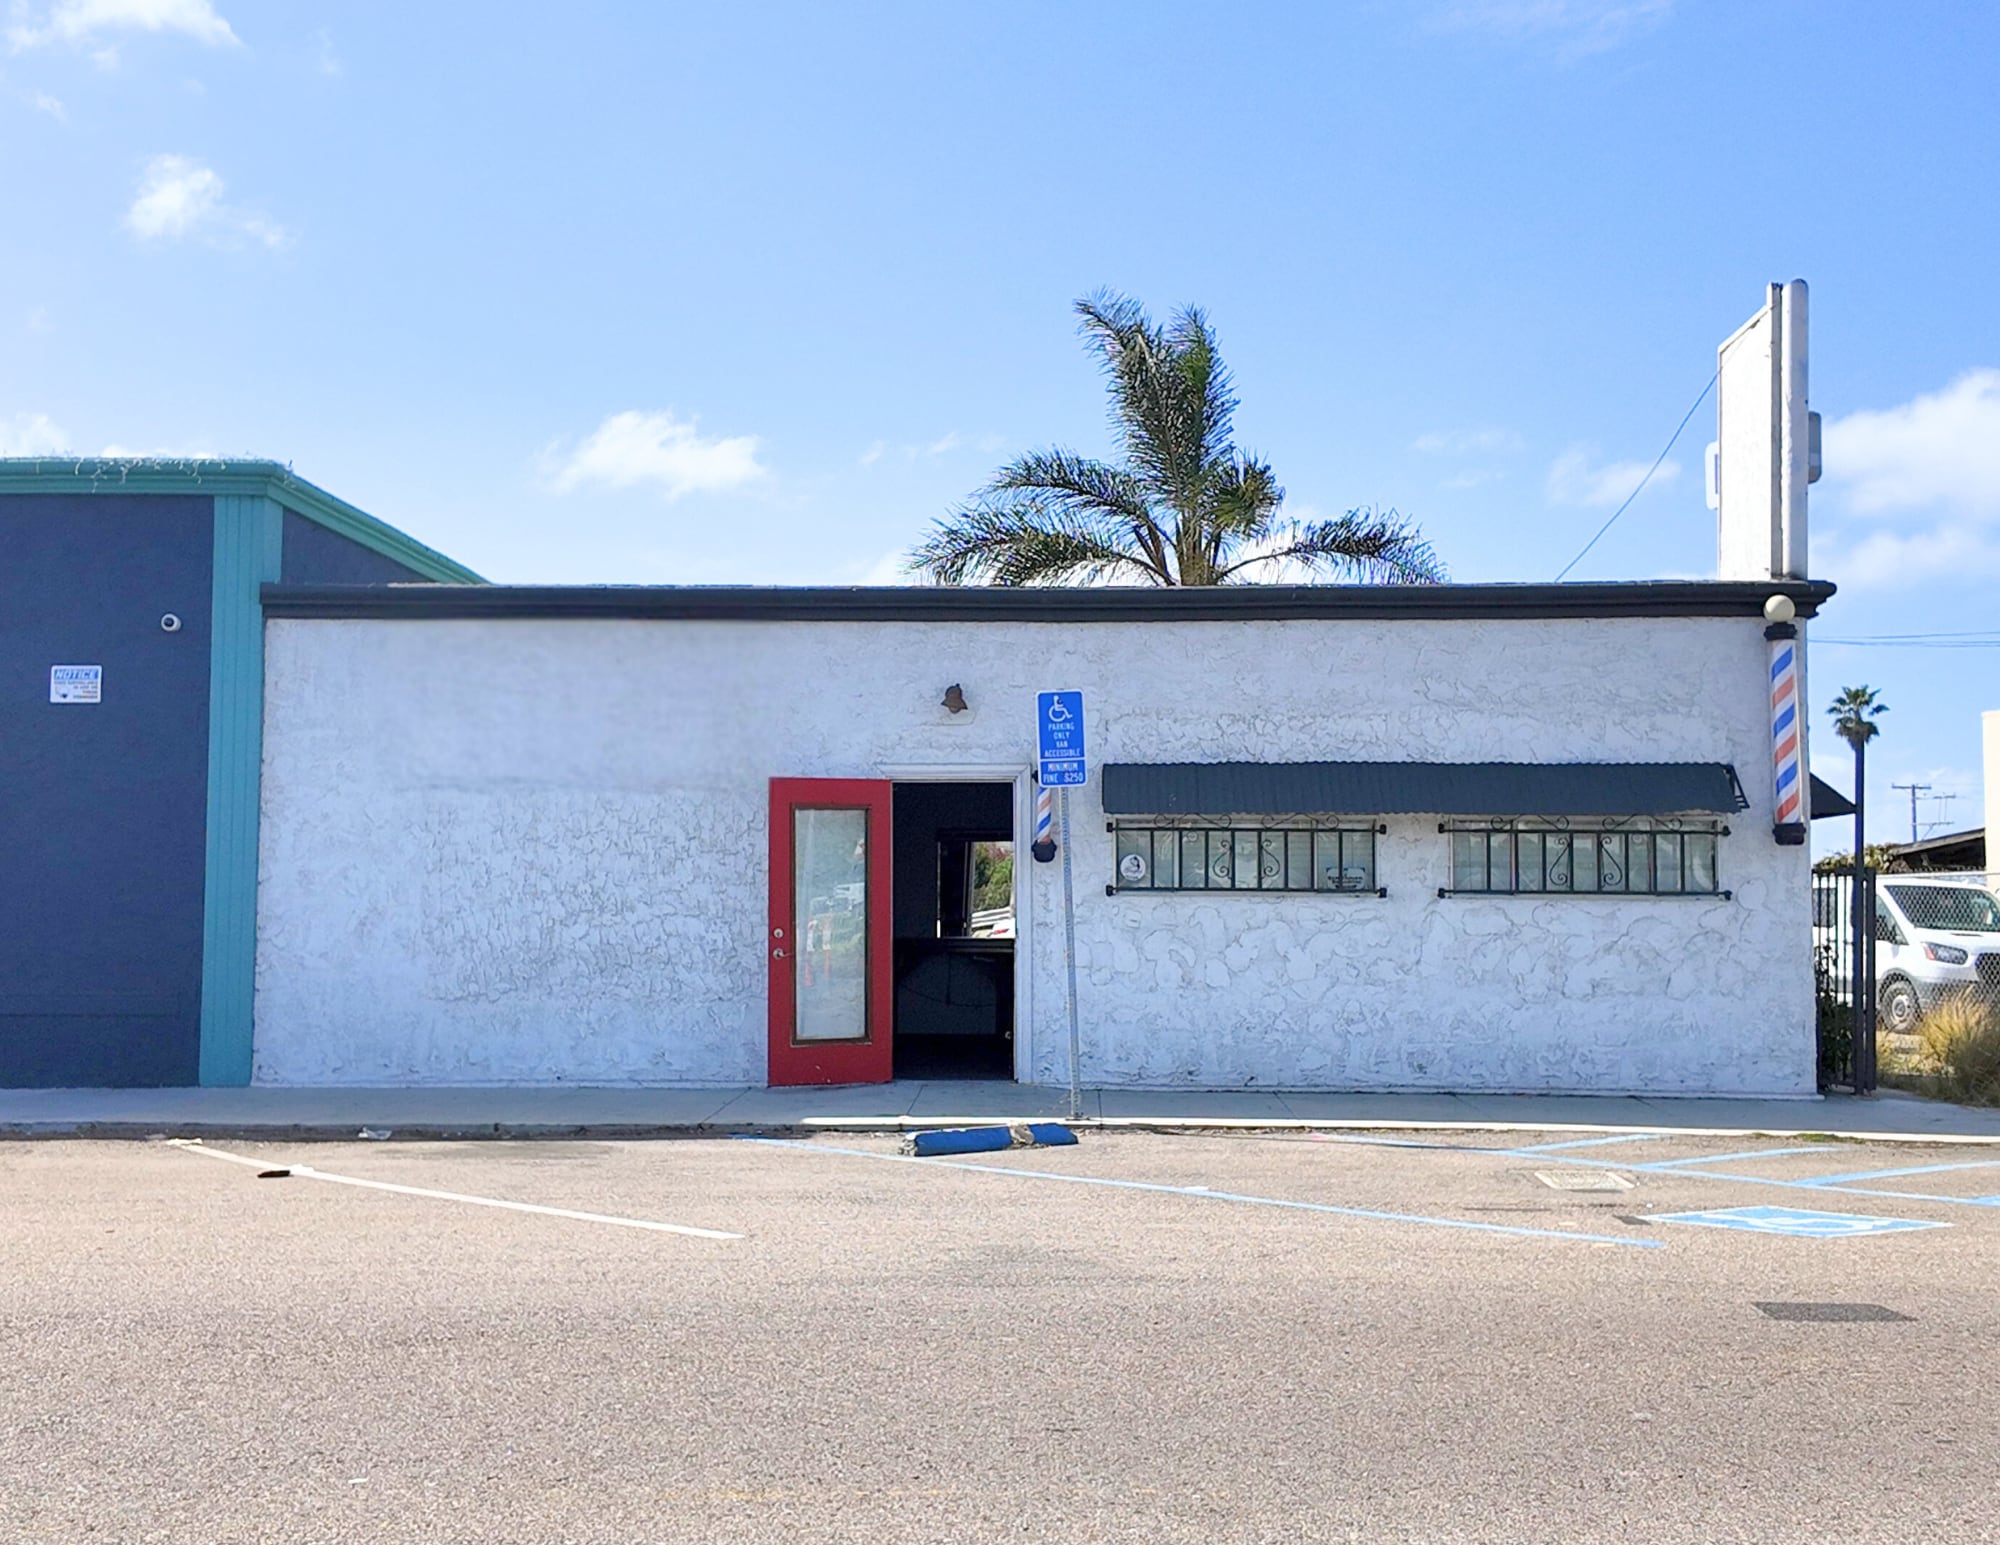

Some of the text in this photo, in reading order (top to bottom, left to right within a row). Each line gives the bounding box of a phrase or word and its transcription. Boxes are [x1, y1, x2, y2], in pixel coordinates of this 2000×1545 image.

[1048, 722, 1075, 731] PARKING
[1053, 731, 1070, 740] ONLY
[1044, 748, 1080, 757] ACCESSIBLE
[1048, 762, 1078, 772] MINIMUM
[1043, 772, 1083, 783] FINE $250
